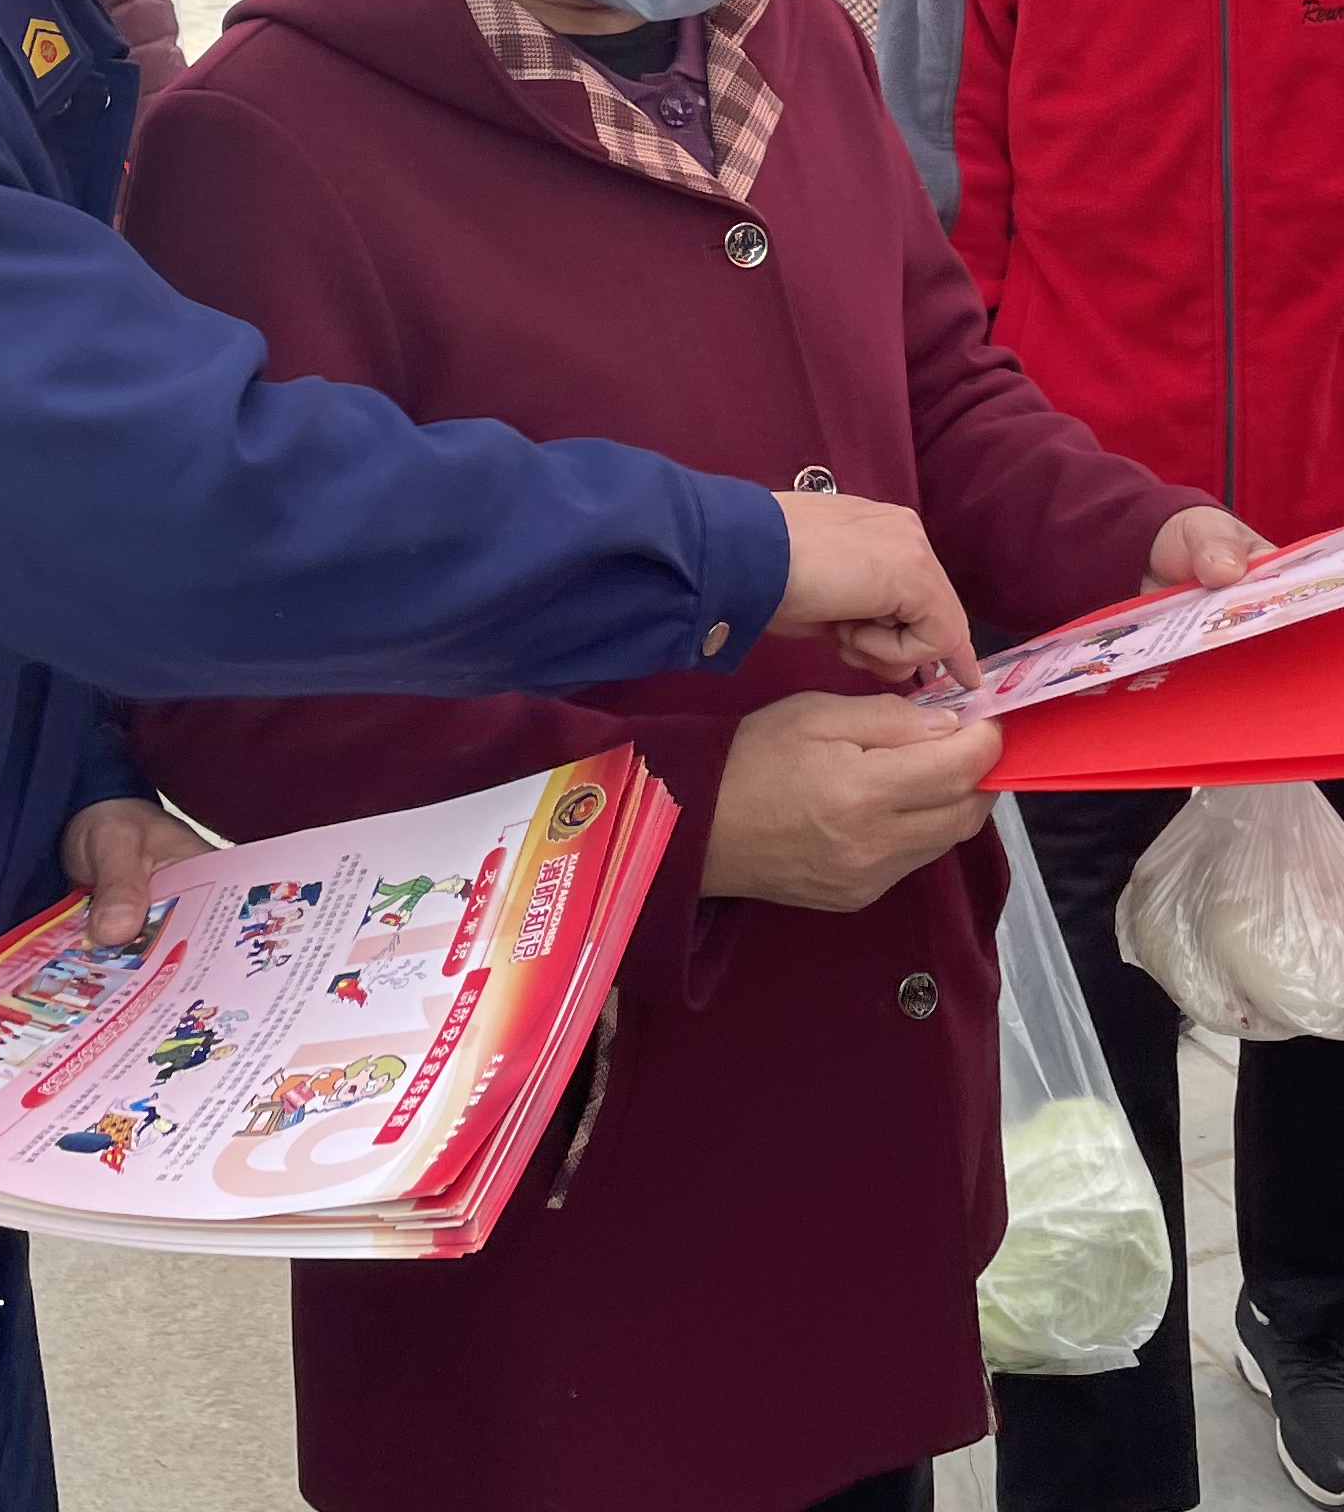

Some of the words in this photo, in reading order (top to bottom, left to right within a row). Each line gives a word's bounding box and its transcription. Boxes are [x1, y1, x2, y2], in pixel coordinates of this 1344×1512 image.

[451, 868, 497, 961] 灭火常识
[509, 854, 569, 963] 消防知识
[541, 851, 580, 956] XIAOFANGZHISHI
[387, 988, 478, 1128] 消防安全宣传教育
